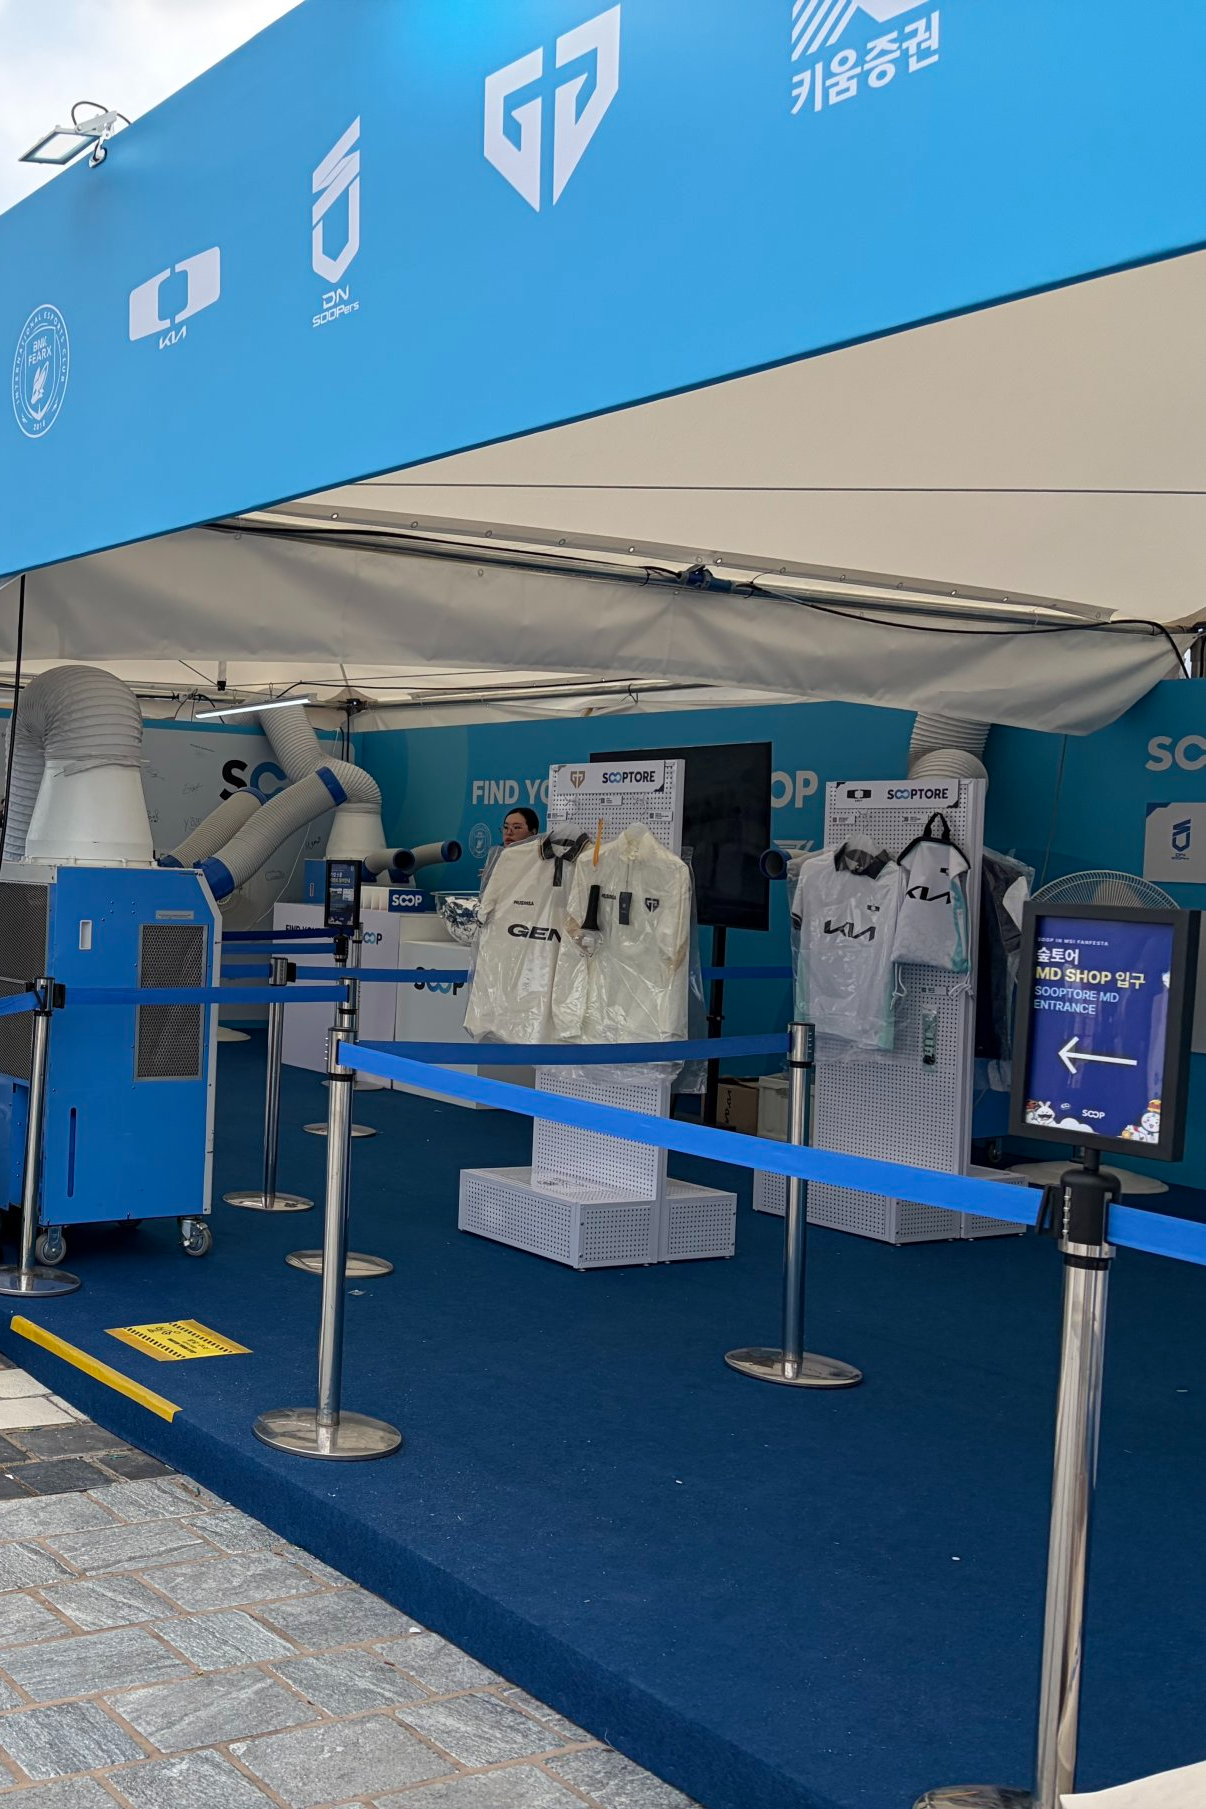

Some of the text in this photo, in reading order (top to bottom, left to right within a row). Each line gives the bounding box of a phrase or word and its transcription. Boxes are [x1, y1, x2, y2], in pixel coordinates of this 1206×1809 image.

[790, 9, 940, 115] 키움증권
[322, 284, 350, 309] DN
[312, 300, 360, 328] SOOPers
[33, 335, 48, 353] BNK
[158, 325, 187, 350] KIA
[28, 345, 52, 368] FEARX
[601, 770, 656, 784] SOOPTORE
[472, 779, 519, 805] FIND
[886, 788, 949, 800] SOOPTORE
[391, 893, 423, 907] SOOP
[1035, 947, 1080, 965] 숲토어
[1035, 966, 1146, 990] MD SHOP 입구
[1034, 985, 1120, 1003] SOOPTORE MD
[1033, 999, 1097, 1015] ENTRANCE
[1081, 1108, 1106, 1119] SOOP
